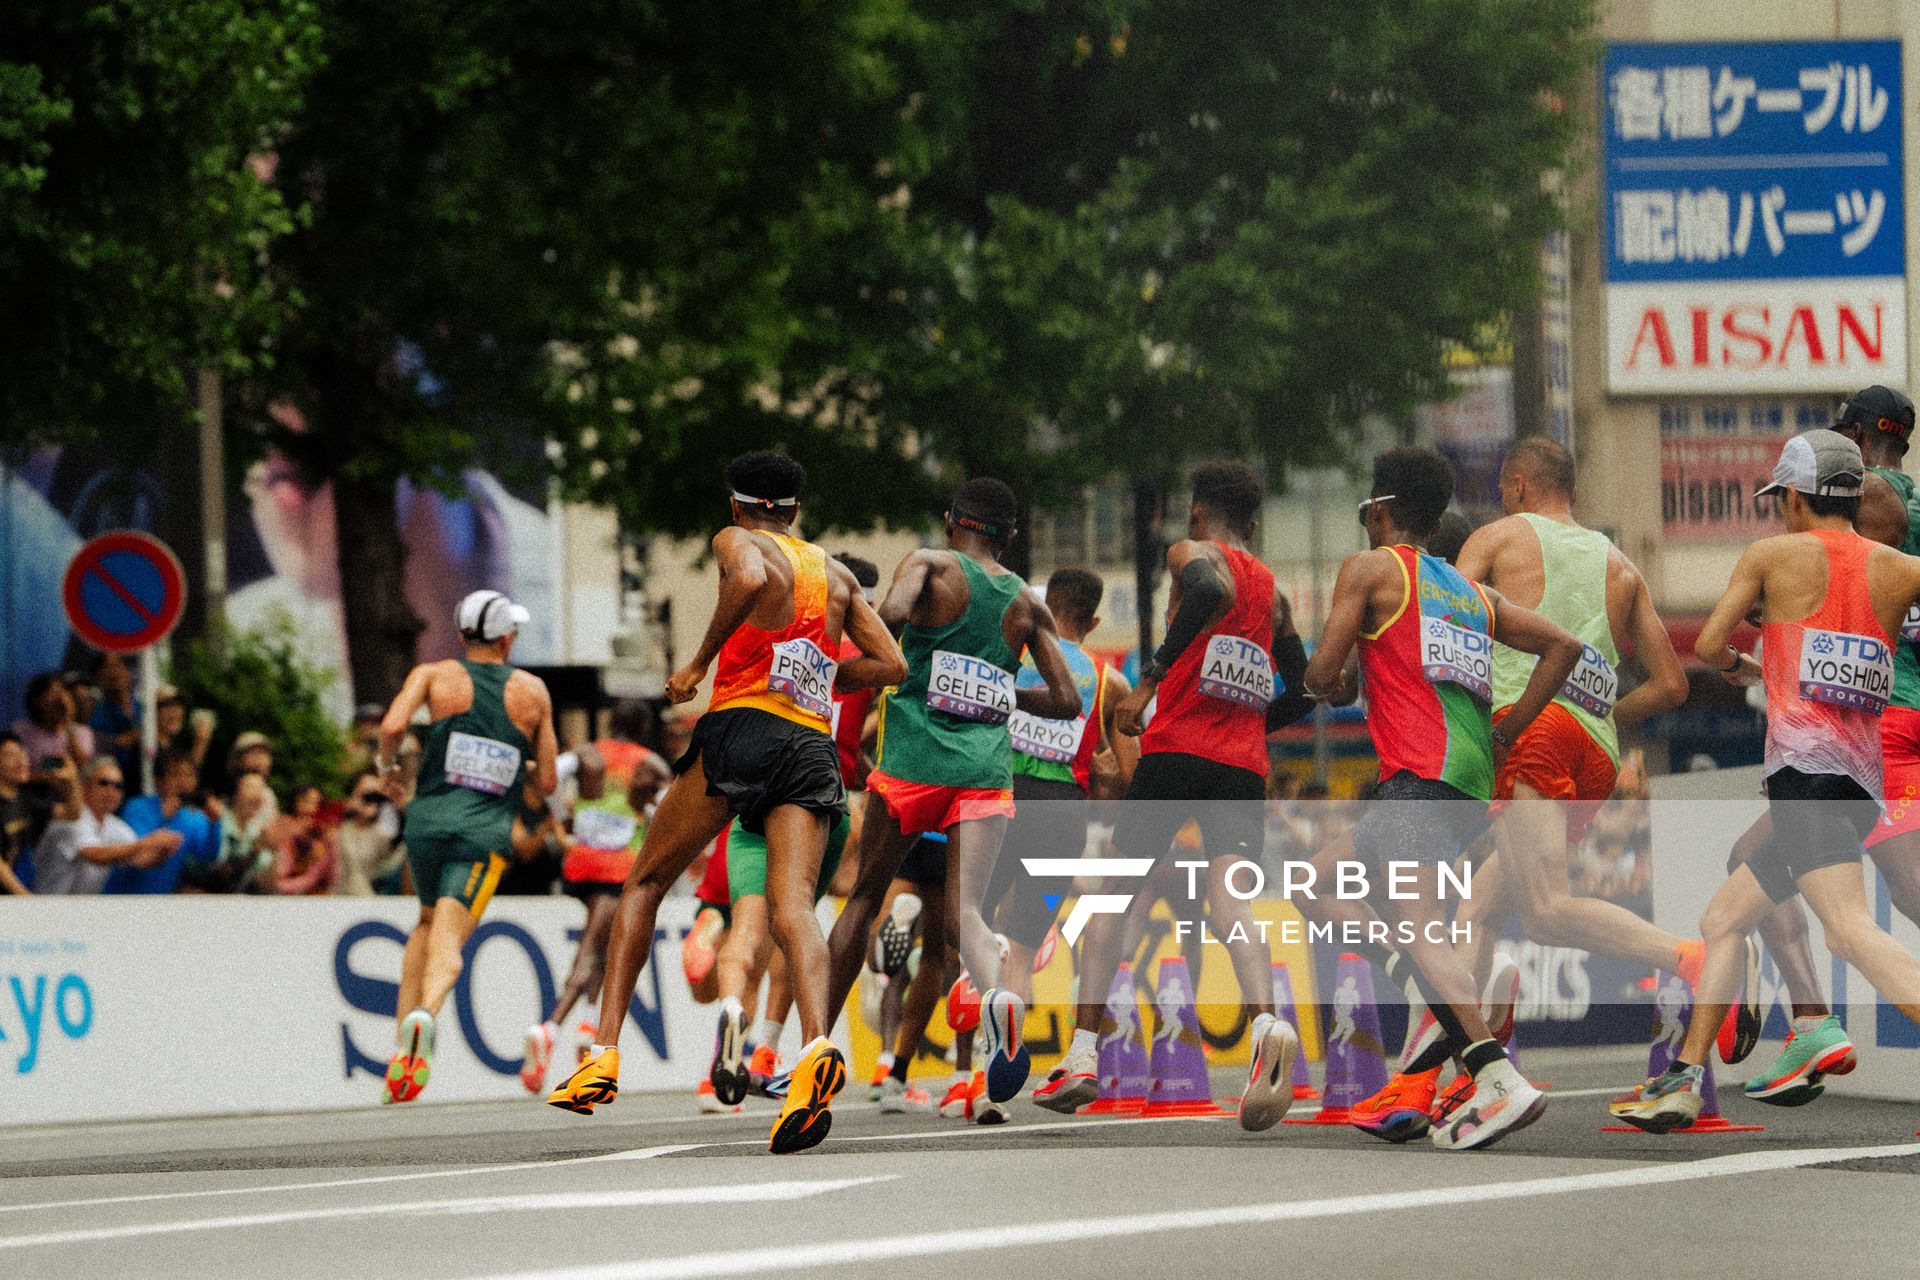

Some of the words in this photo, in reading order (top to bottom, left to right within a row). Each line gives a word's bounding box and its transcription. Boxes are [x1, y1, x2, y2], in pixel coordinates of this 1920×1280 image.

[1610, 62, 1888, 141] 各種ケーブル
[1613, 185, 1886, 264] 配線パーツ
[1623, 302, 1887, 371] AISAN
[799, 640, 834, 681] TDK
[1582, 643, 1612, 676] DK
[1835, 635, 1890, 669] TDK
[778, 655, 828, 702] PETROS
[936, 674, 1010, 711] GELETA
[958, 657, 1009, 690] TDK
[1207, 660, 1271, 697] AMARE
[1571, 667, 1614, 699] LATOV
[1808, 658, 1889, 697] YOSHIDA
[335, 920, 757, 1079] SON
[0, 973, 93, 1075] yo
